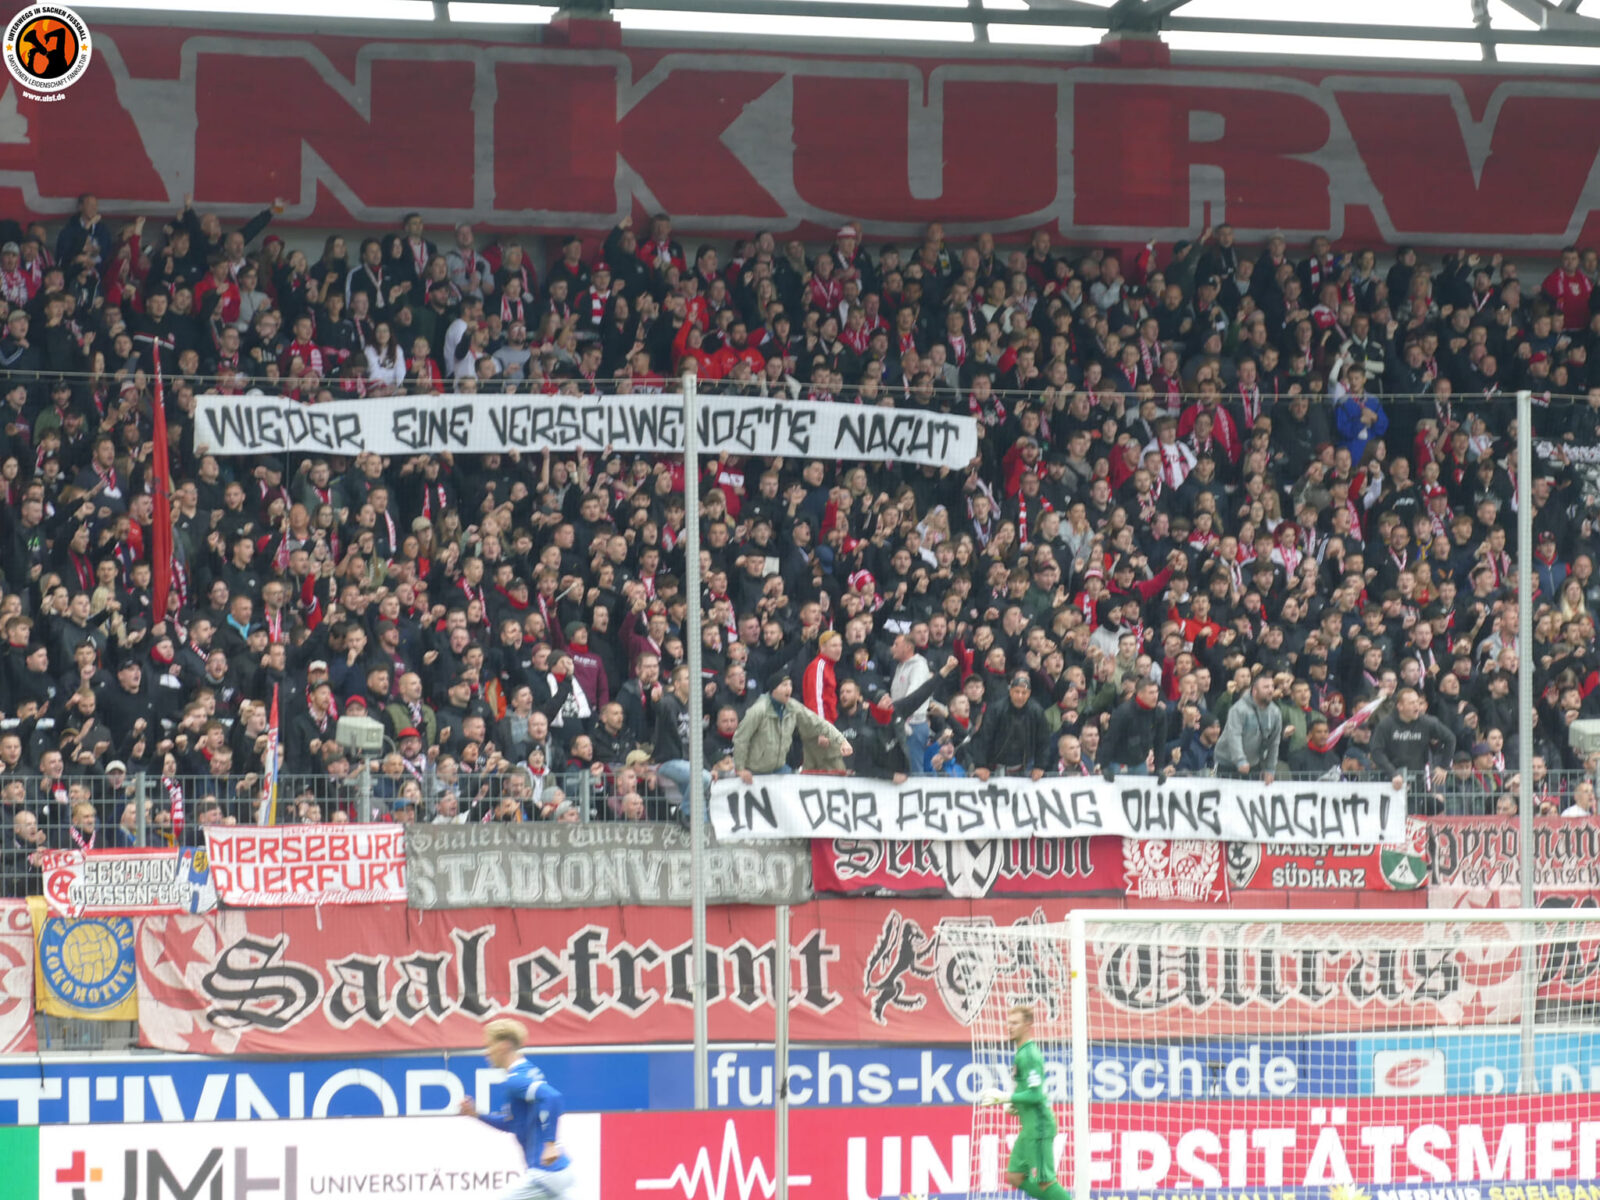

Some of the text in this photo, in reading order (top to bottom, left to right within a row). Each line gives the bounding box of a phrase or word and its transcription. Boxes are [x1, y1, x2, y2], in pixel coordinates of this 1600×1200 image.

[205, 404, 364, 449] WIEDER
[392, 404, 473, 449] EINE
[727, 787, 778, 832] IN
[800, 788, 883, 832] DER
[896, 784, 1103, 833] FESTUNG
[1121, 789, 1222, 835] OHNE
[84, 858, 177, 885] SEKTION
[1271, 861, 1366, 889] SÜDHARZ
[45, 944, 135, 1004] LOKOMOTIVE
